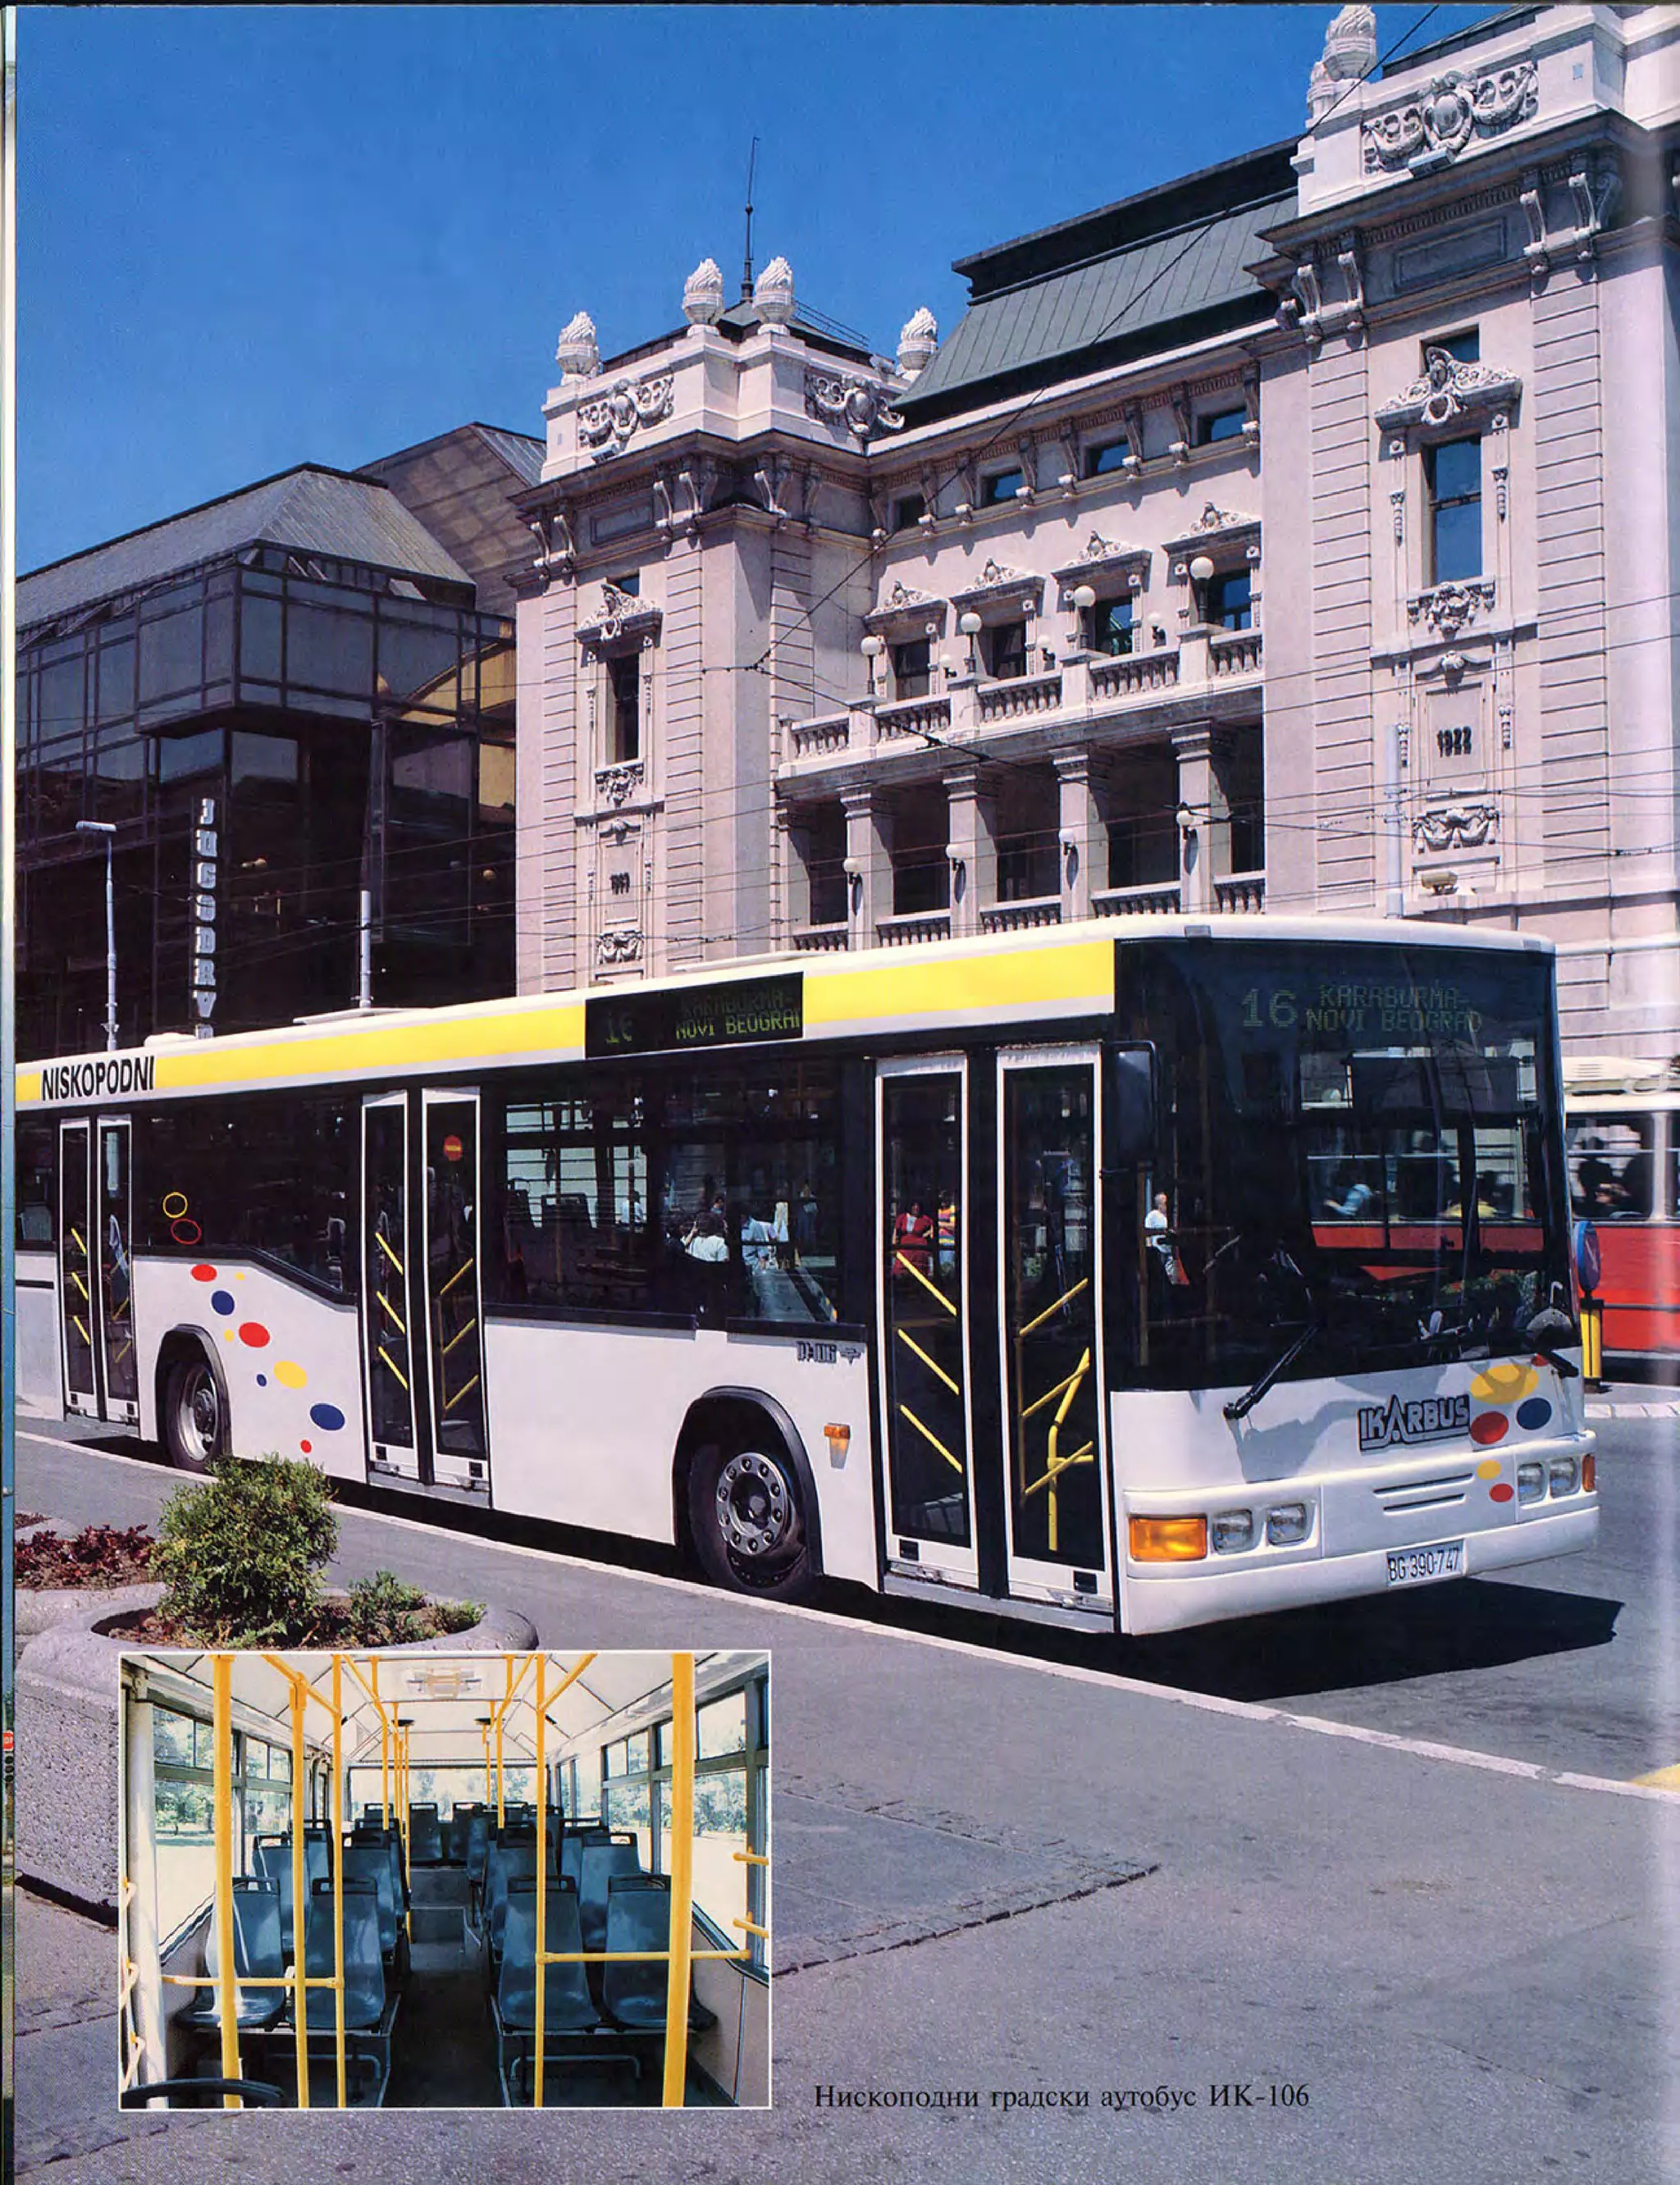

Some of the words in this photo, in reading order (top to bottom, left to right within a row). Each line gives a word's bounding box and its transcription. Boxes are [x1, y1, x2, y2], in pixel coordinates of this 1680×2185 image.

[1242, 988, 1298, 1028] 16
[1307, 1009, 1366, 1032] NOVI
[1382, 1010, 1481, 1033] BEOGRAD
[676, 1018, 715, 1040] NOVI
[43, 1056, 154, 1101] NISKOPODNI
[1358, 1394, 1470, 1450] IKARBUS
